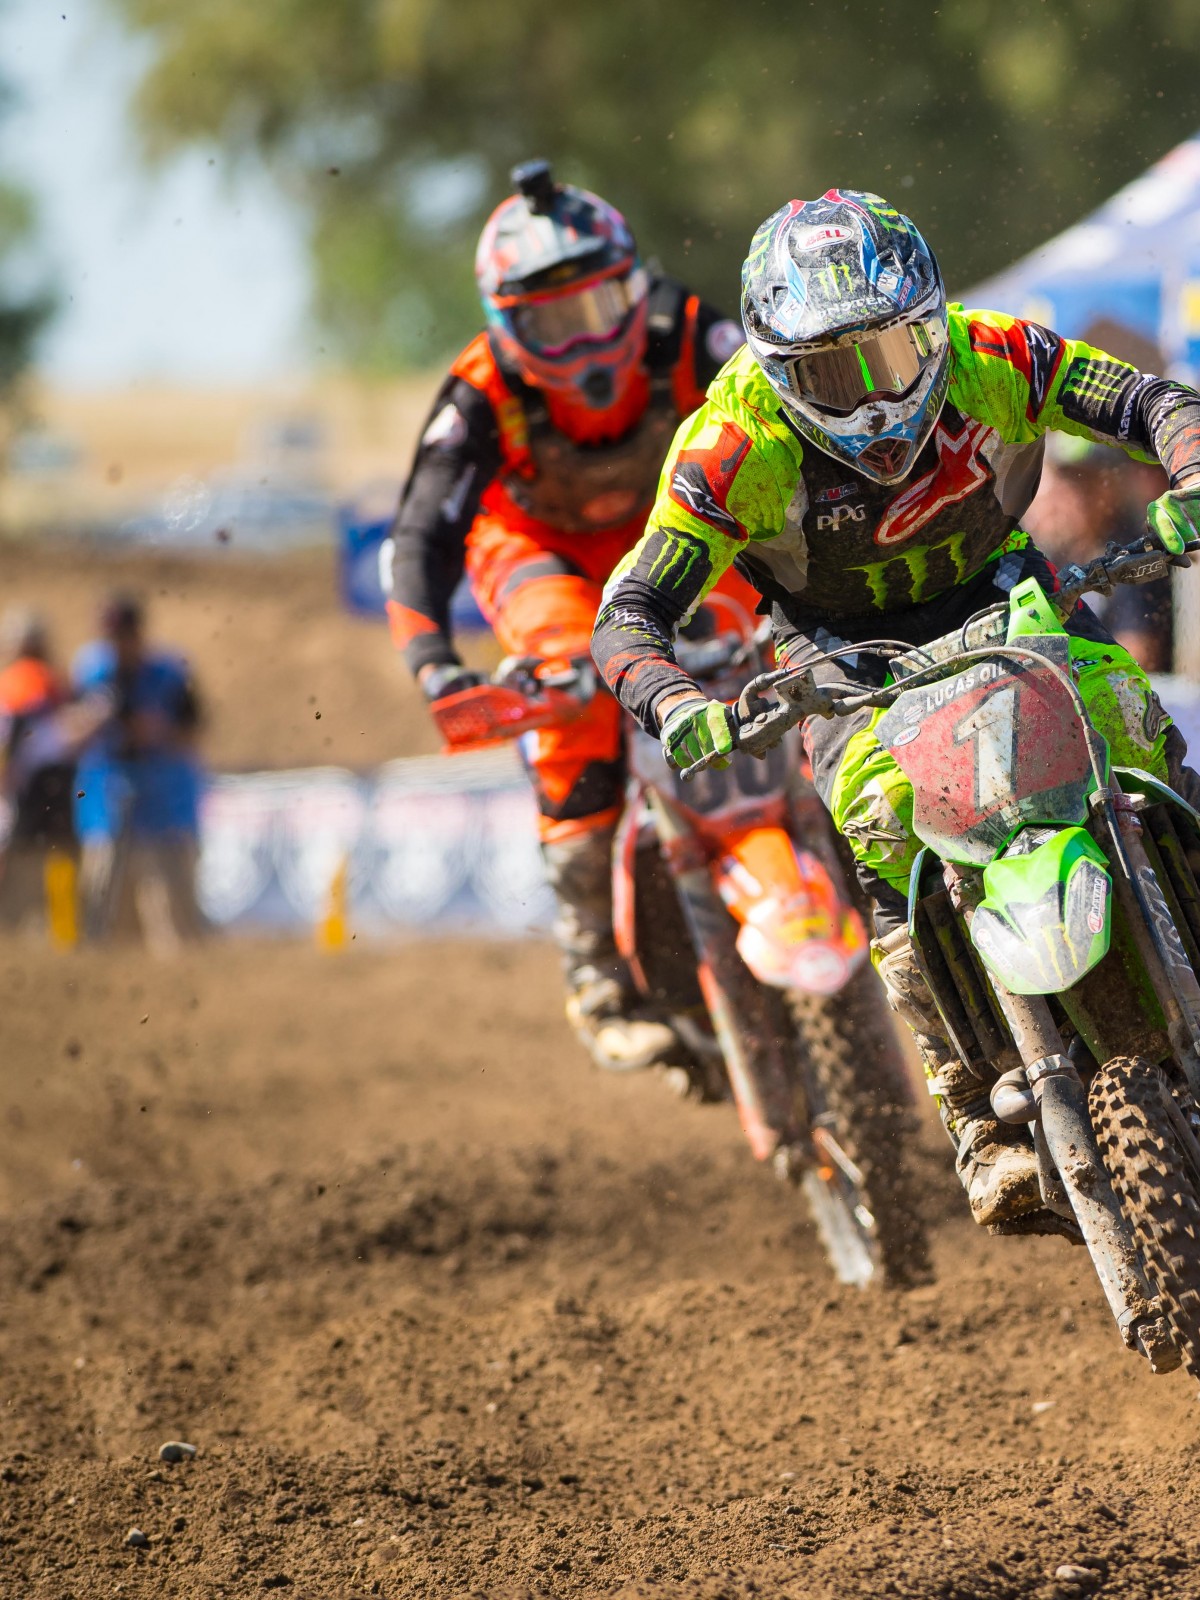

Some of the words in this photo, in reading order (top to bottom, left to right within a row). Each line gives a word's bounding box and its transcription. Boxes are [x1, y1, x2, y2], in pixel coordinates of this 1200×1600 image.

[805, 229, 846, 247] BELL
[816, 296, 893, 320] ONSTER
[816, 504, 866, 531] PPG
[925, 673, 975, 712] LUCAS
[979, 662, 1008, 682] OIL
[956, 686, 1017, 809] 1
